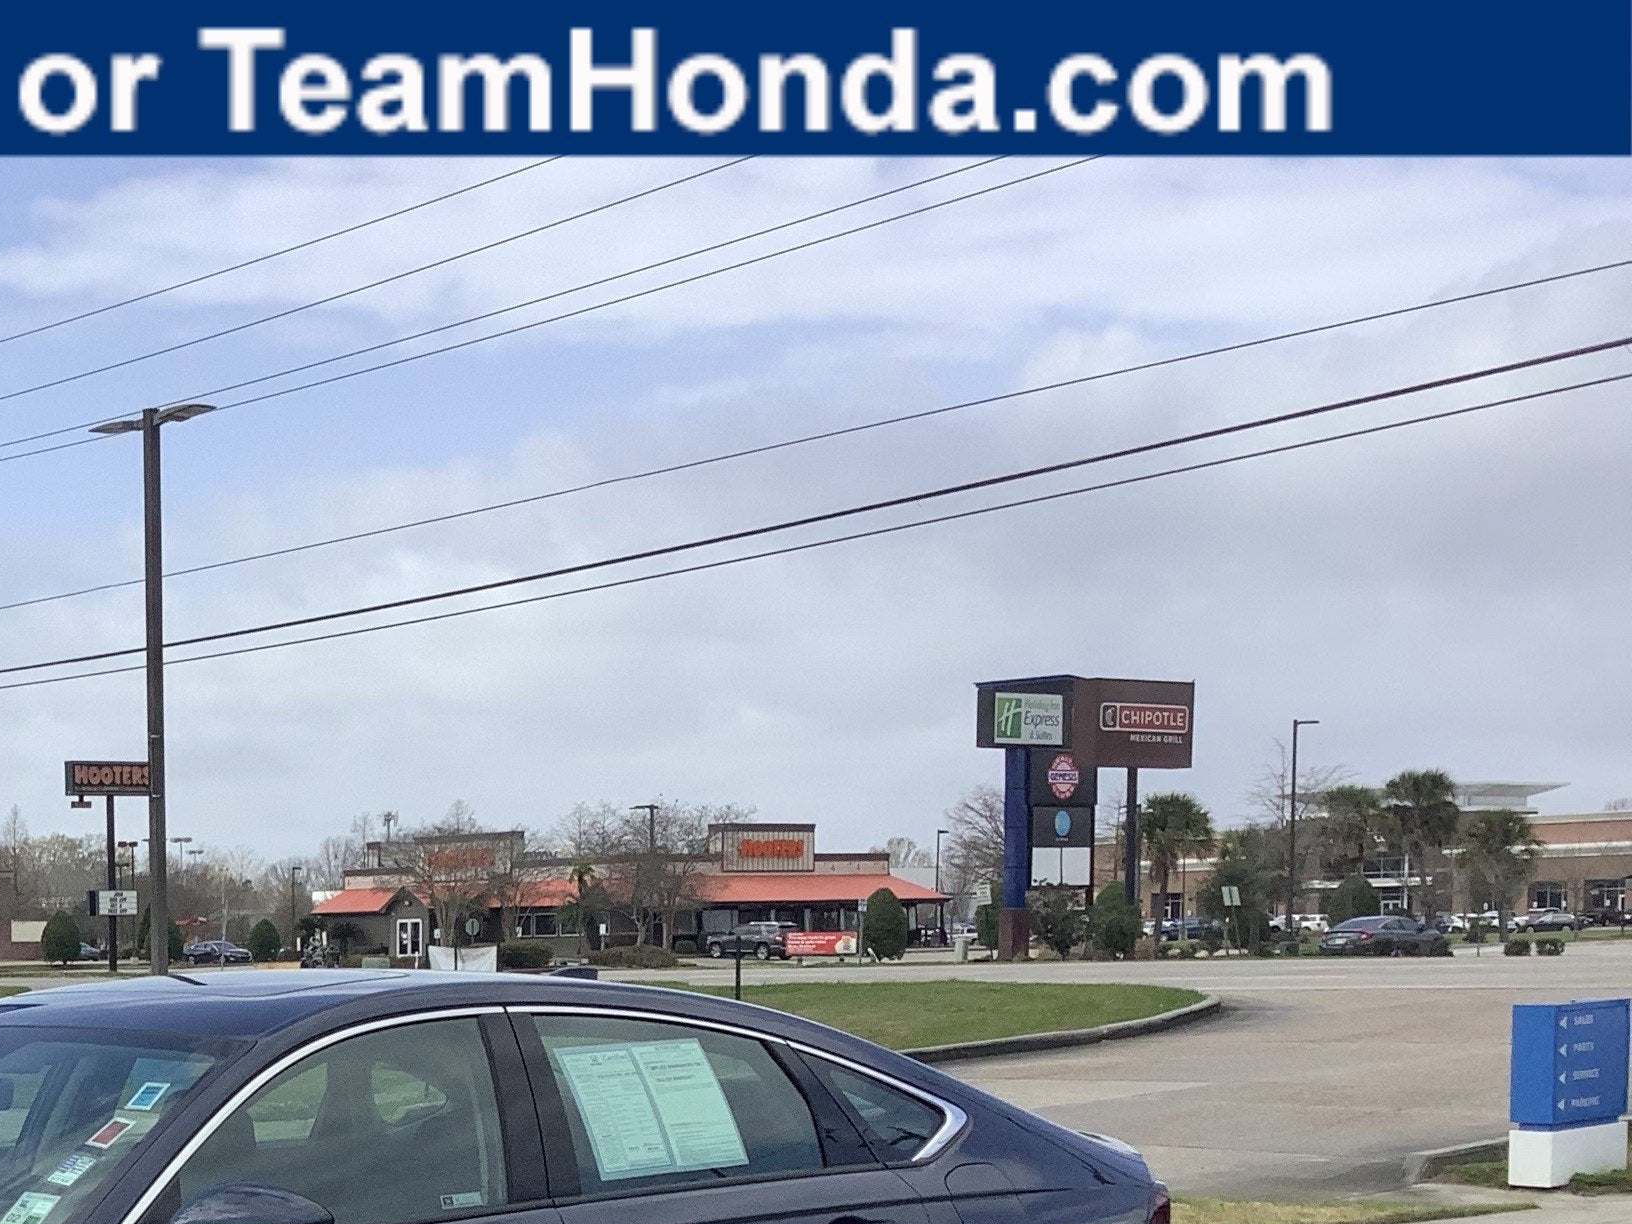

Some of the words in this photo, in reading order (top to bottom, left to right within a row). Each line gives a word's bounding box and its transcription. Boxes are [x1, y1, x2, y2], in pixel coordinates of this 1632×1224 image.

[1023, 710, 1060, 728] Express
[1121, 710, 1185, 727] CHIPOTLE
[1129, 734, 1162, 743] MEXICAN
[1163, 735, 1183, 744] GRILL
